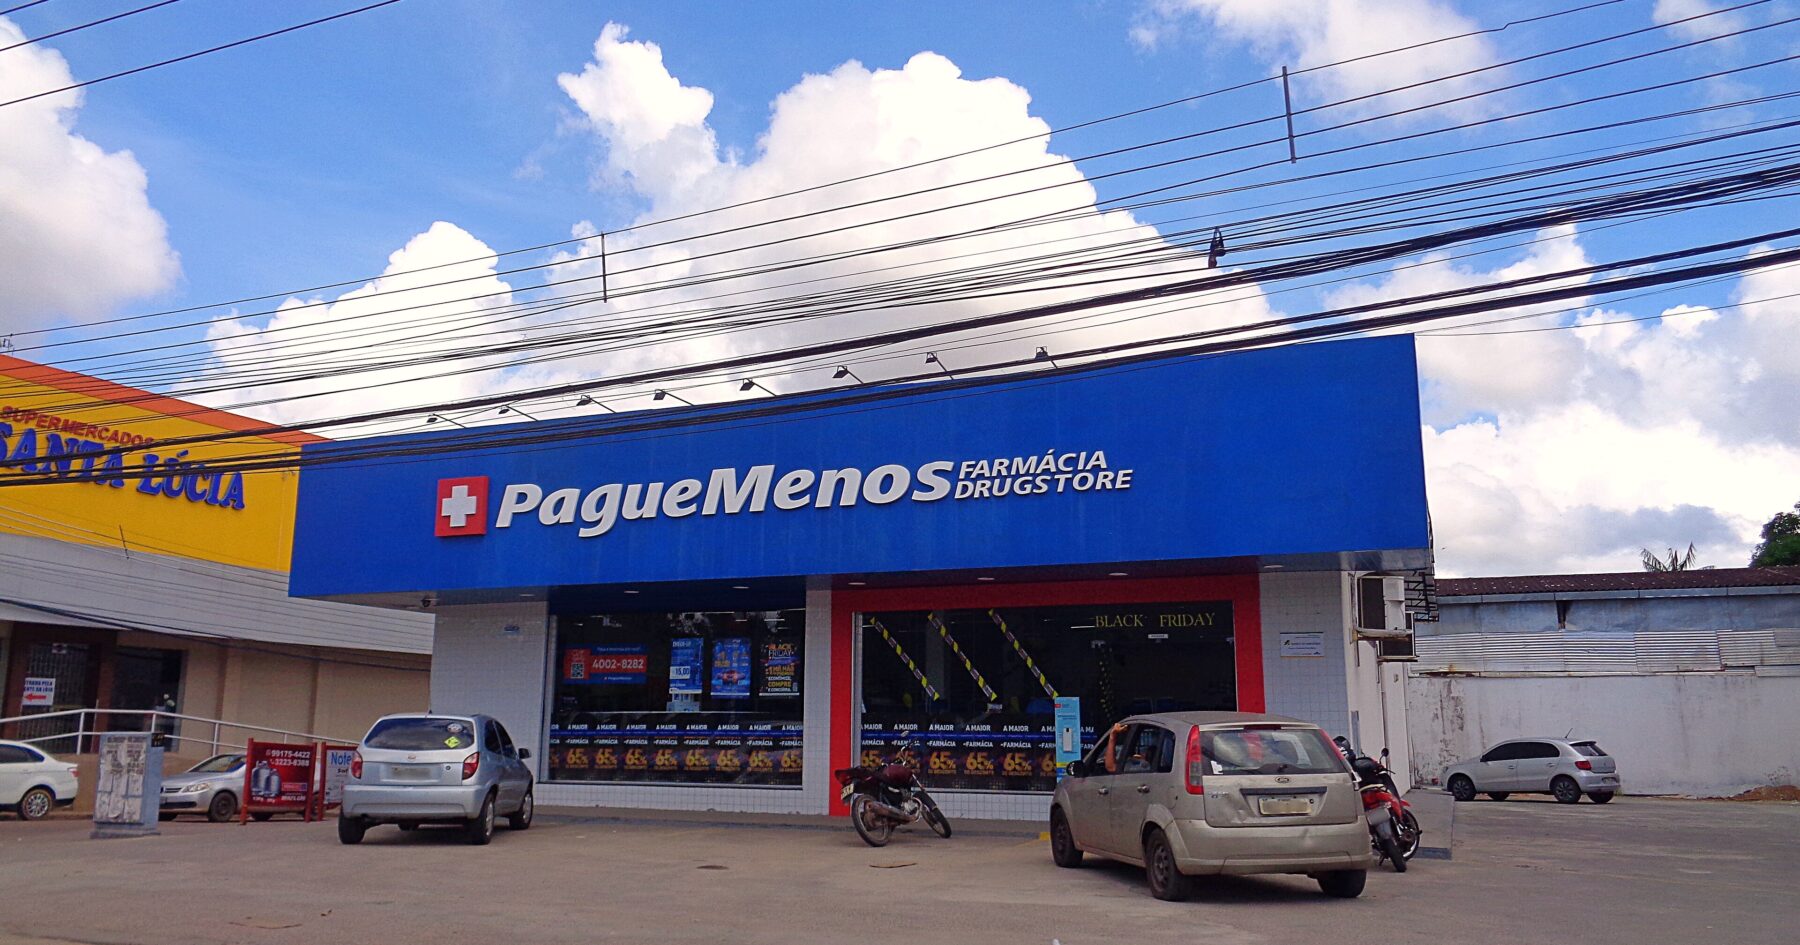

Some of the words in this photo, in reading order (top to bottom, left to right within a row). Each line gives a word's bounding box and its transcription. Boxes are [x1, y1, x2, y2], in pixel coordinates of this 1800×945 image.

[0, 421, 125, 487] SANTA
[137, 449, 245, 510] LÚCIA
[958, 448, 1109, 480] FARMÁCIA
[954, 469, 1134, 500] DRUGSTORE
[1095, 614, 1144, 628] BLACK
[1159, 612, 1216, 627] FRIDAY
[592, 658, 645, 669] 4002-8282
[929, 751, 956, 770] 65%
[966, 752, 994, 771] 65%
[1003, 753, 1032, 772] 65%
